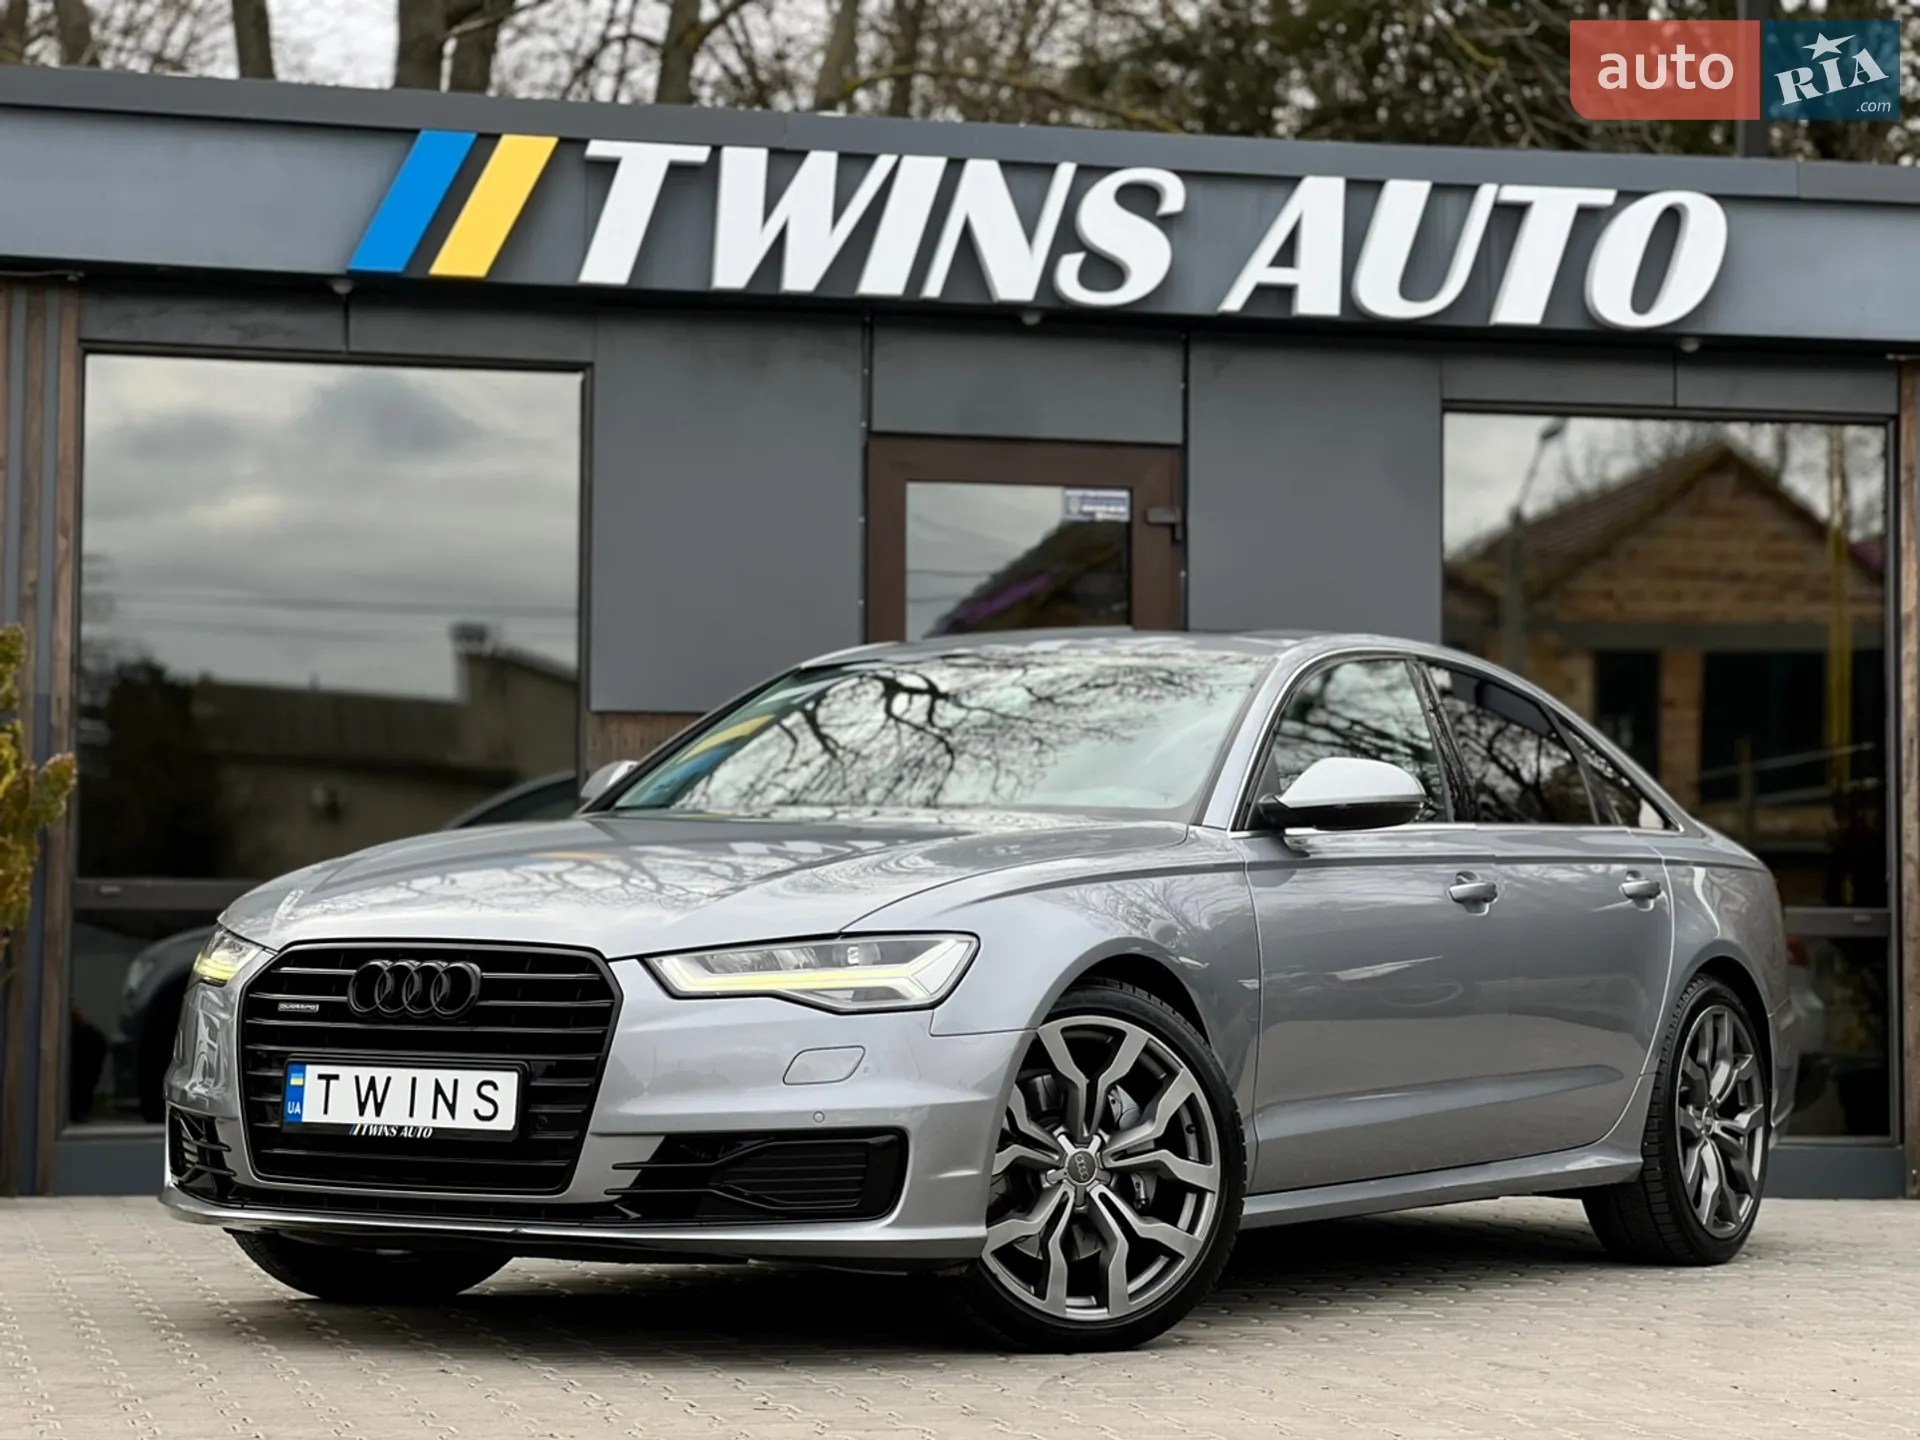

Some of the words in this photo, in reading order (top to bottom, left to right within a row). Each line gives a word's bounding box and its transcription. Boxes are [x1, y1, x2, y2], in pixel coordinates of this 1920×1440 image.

[578, 139, 1186, 307] TWINS
[1216, 175, 1728, 330] AUTO
[287, 1101, 301, 1115] UA
[317, 1074, 499, 1122] TWINS
[361, 1123, 399, 1137] TWINS
[399, 1125, 433, 1139] AUTO
